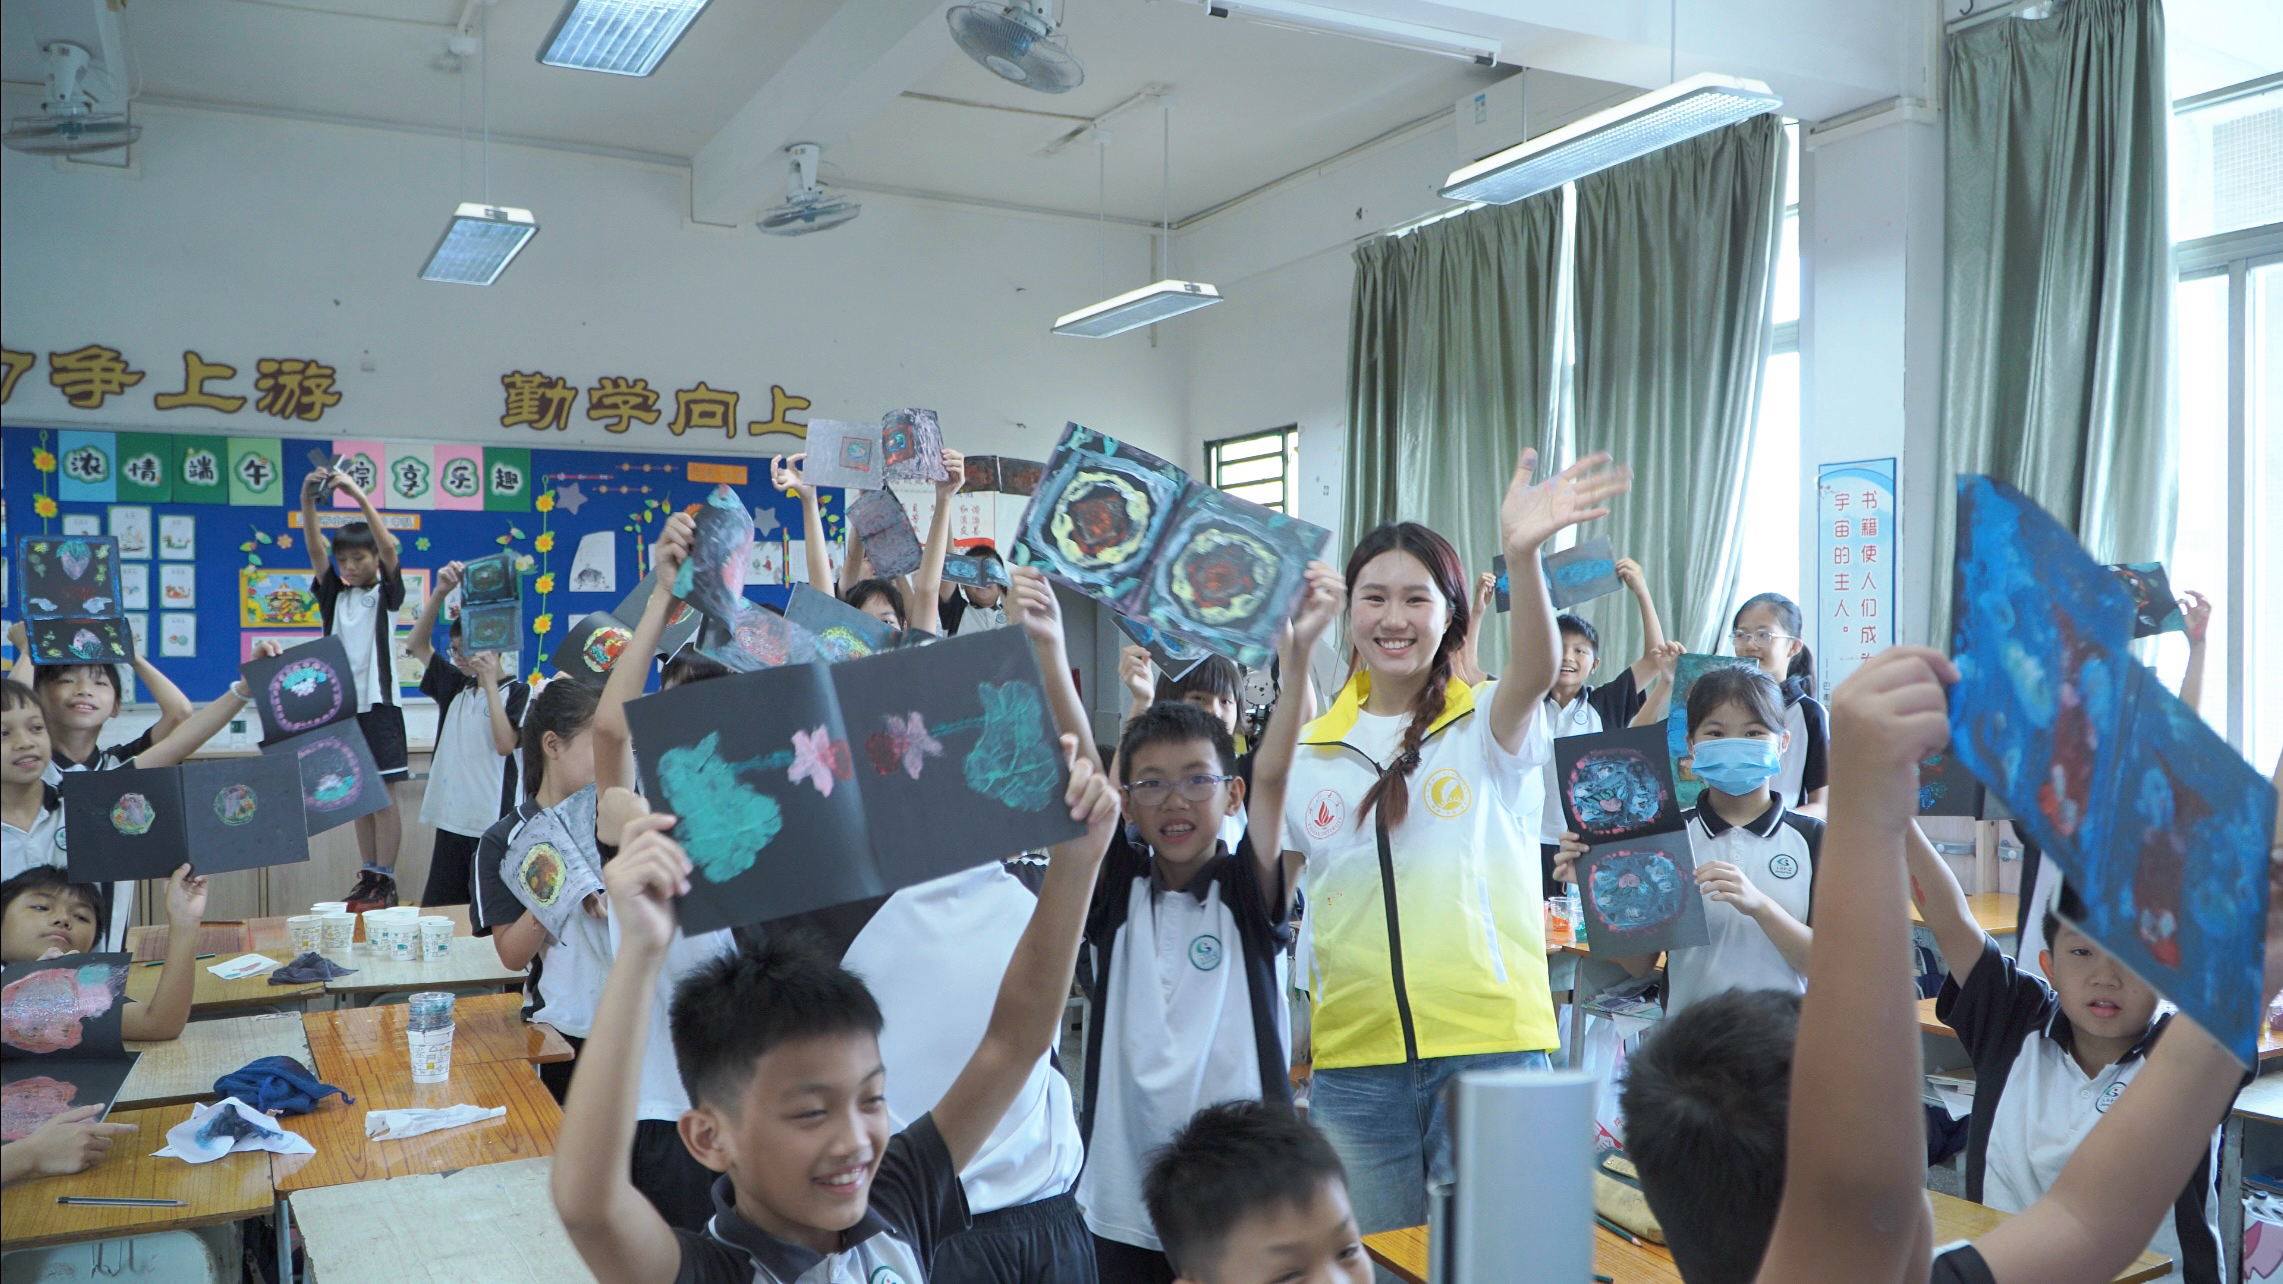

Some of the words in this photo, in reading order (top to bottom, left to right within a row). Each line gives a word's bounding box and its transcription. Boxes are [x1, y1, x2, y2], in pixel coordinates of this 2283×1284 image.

[501, 370, 811, 440] 勤学向上
[70, 449, 270, 486] 浓情端午
[1834, 493, 1850, 633] 宇宙的主人。
